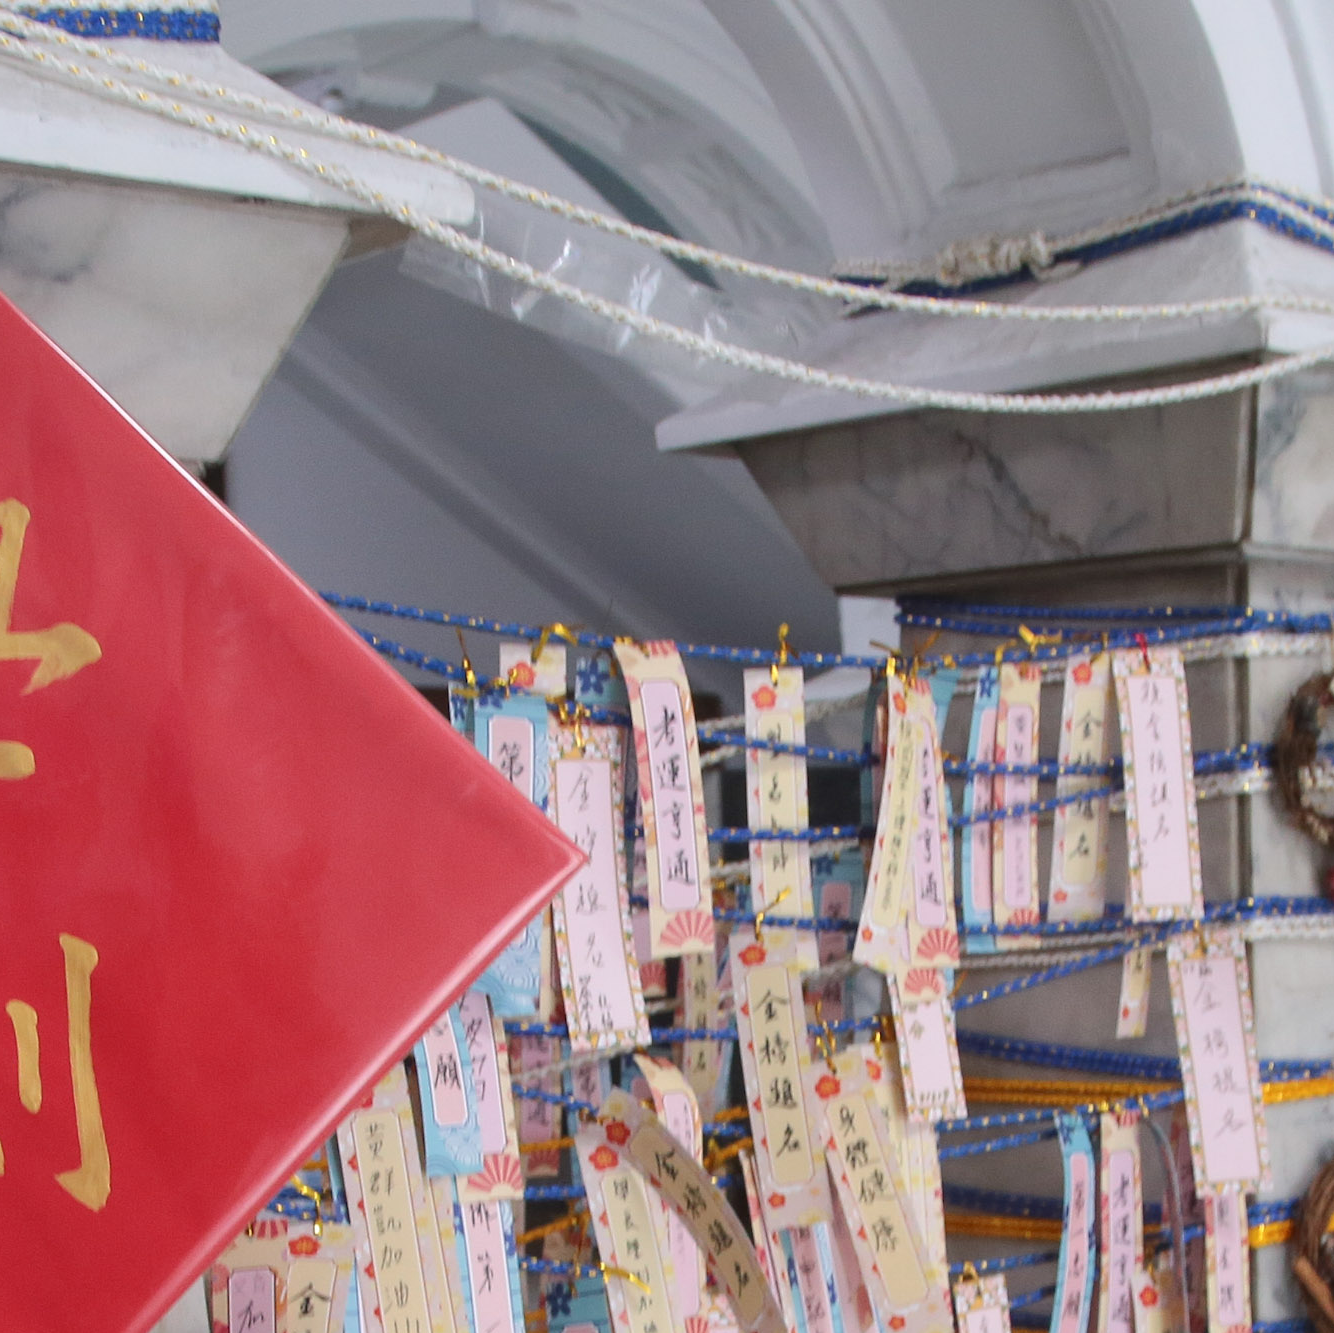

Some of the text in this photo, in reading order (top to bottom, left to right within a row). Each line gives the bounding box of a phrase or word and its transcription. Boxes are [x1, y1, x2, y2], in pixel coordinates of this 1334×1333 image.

[653, 705, 696, 885] 考運亨通
[752, 991, 801, 1157] 金榜題名
[1192, 980, 1244, 1138] 金榜題名
[653, 1149, 751, 1297] 金榜題名
[838, 1106, 898, 1252] 身體健康
[1112, 1174, 1133, 1323] 考運亨通
